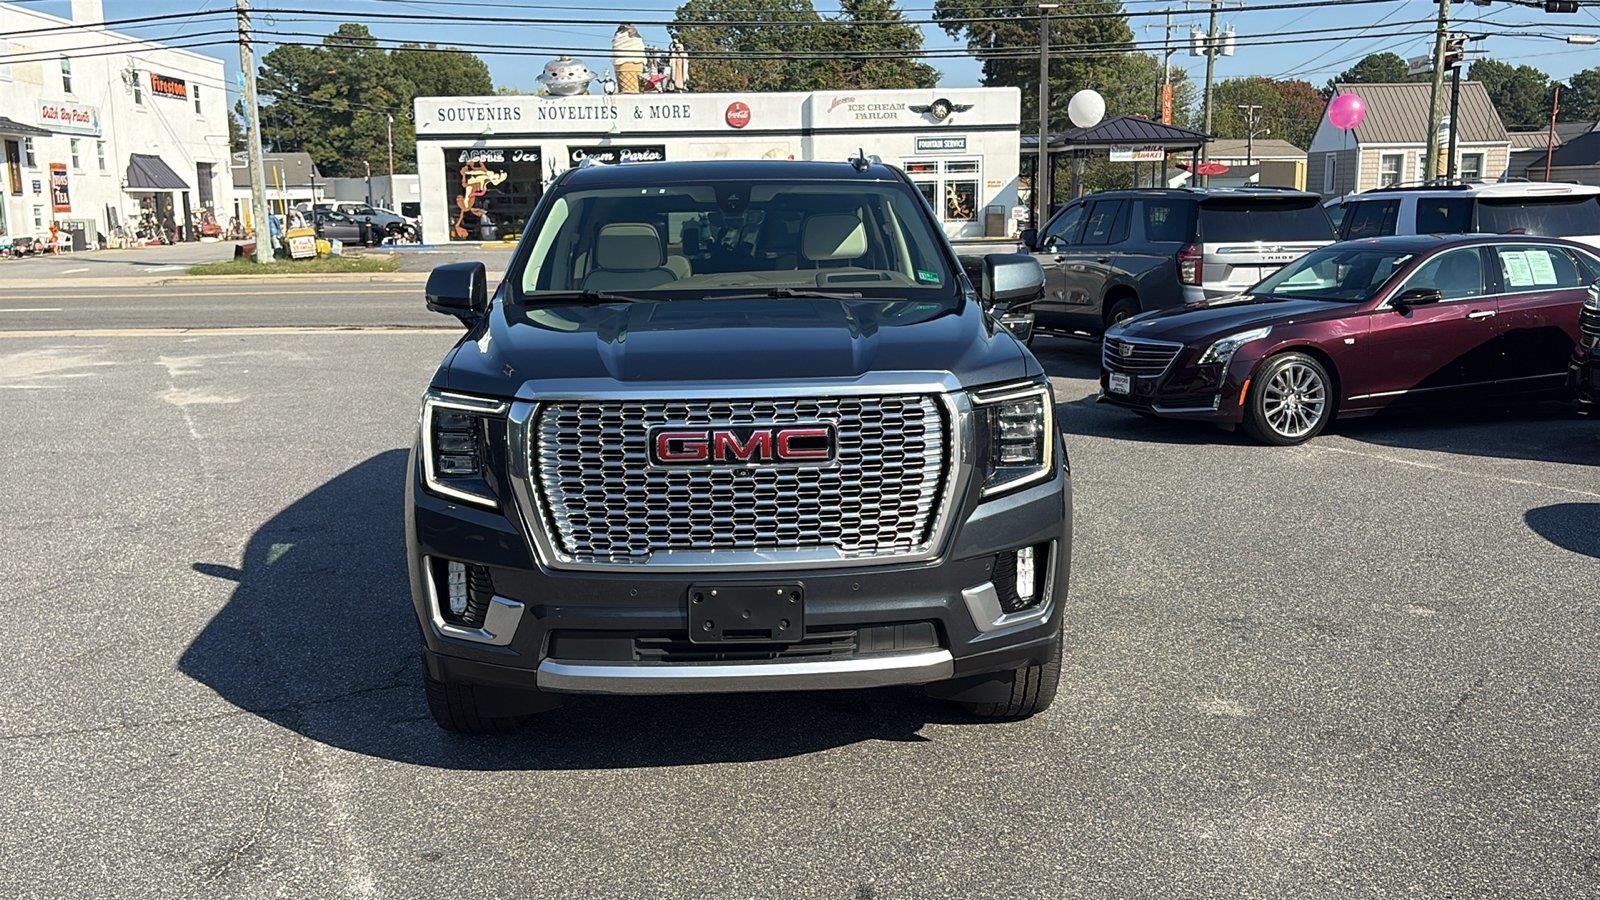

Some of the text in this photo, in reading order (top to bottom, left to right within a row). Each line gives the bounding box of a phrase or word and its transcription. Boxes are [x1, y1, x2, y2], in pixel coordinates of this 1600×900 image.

[151, 74, 186, 97] Firestone
[437, 105, 691, 121] SOUVENIRS NOVELTIES & MORE
[867, 103, 906, 111] CREAM
[42, 105, 90, 124] Dutch Boy Paints
[855, 112, 897, 120] PARLOR
[918, 139, 965, 149] FOUNTAIN SERVICE
[458, 149, 539, 162] ACME Ice
[572, 148, 663, 162] Cream Parlor
[55, 191, 69, 204] TEA
[656, 429, 829, 462] GMC
